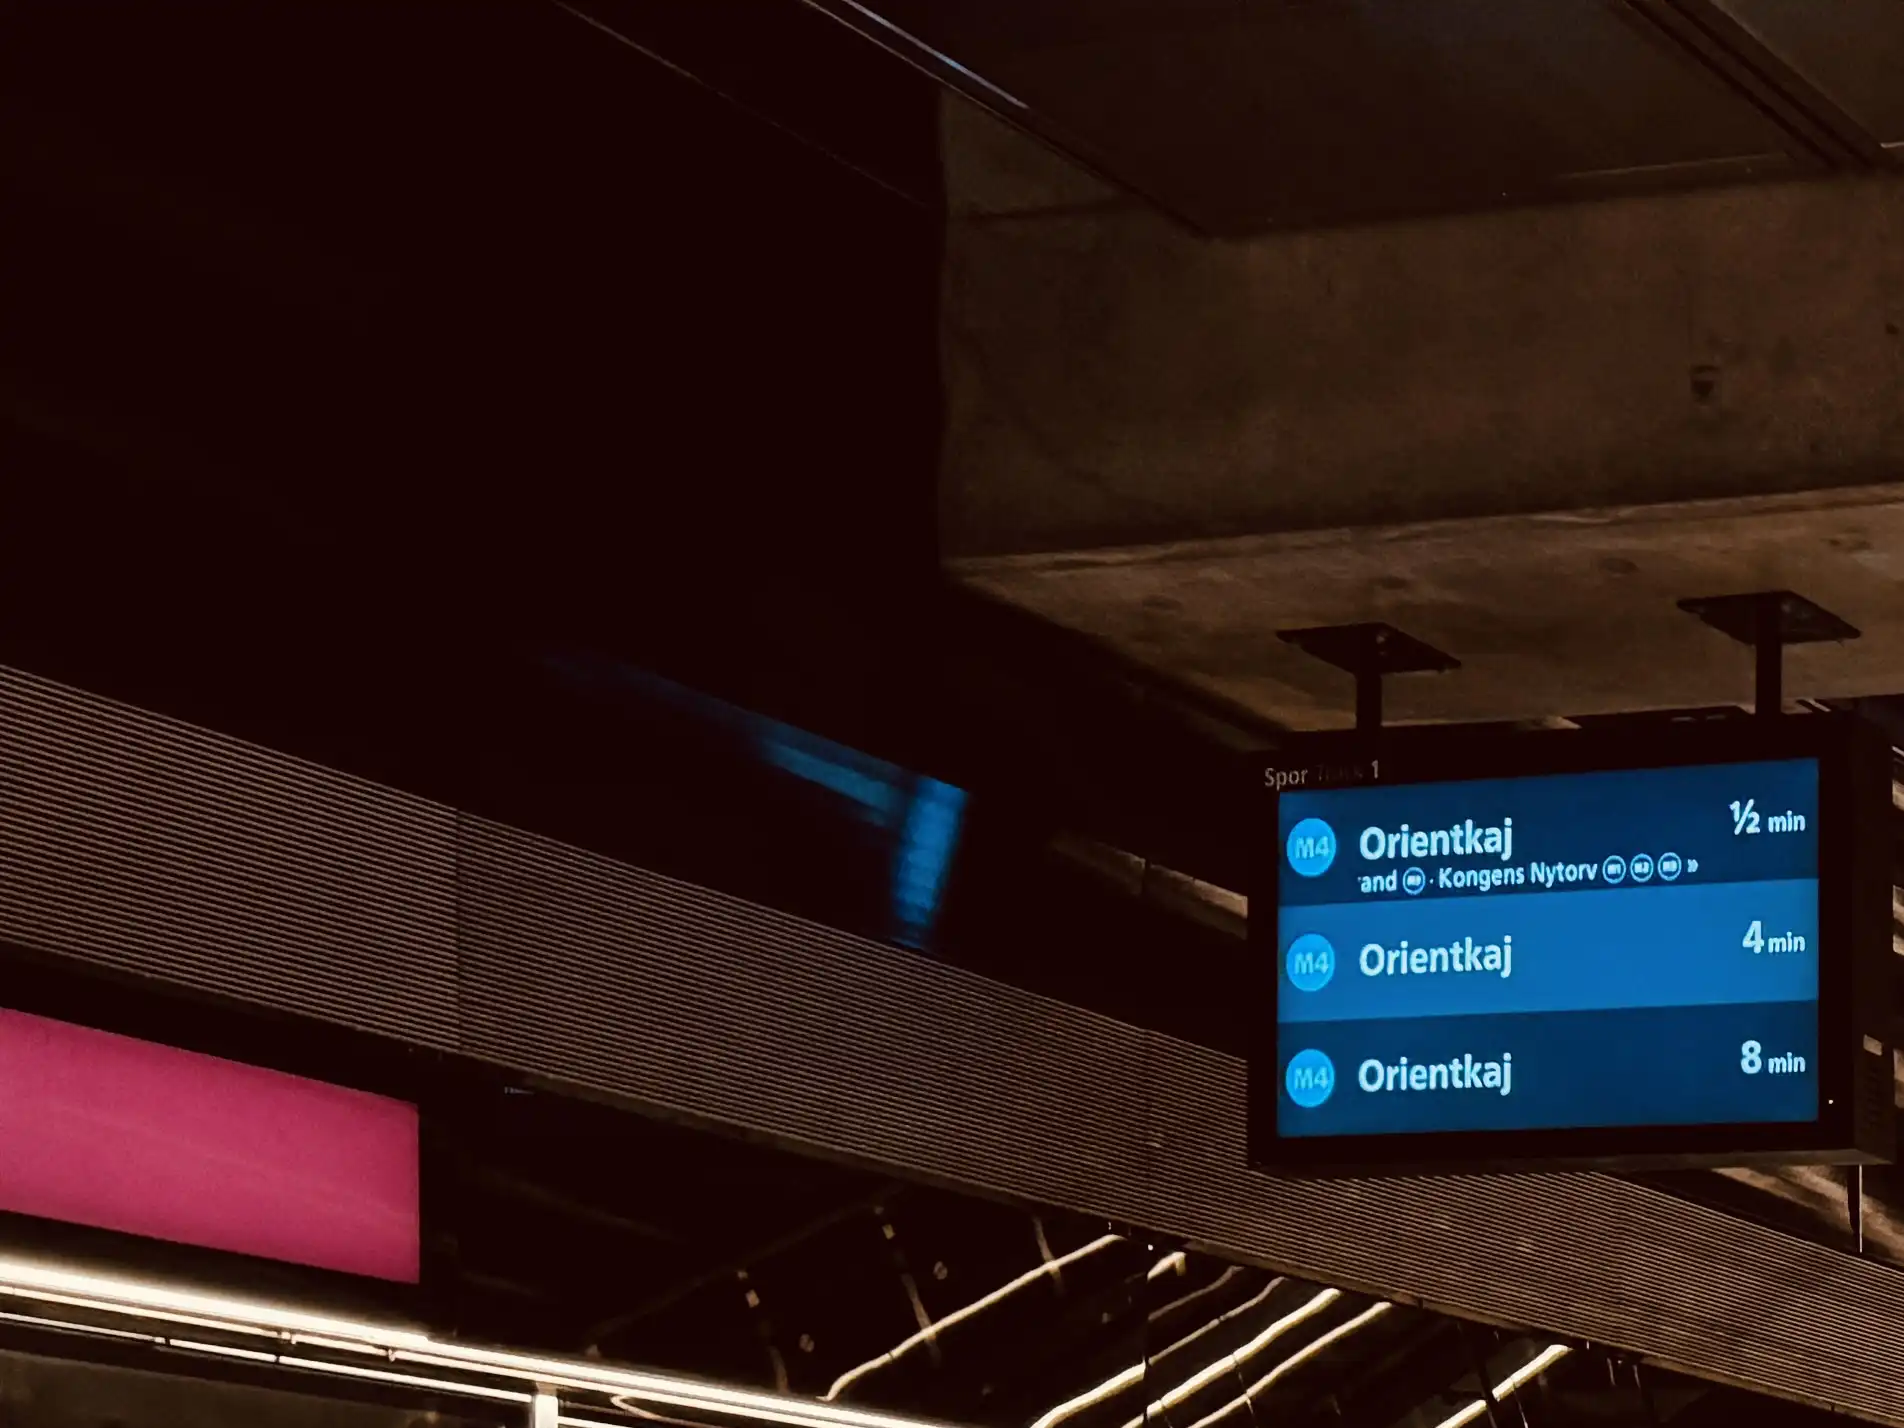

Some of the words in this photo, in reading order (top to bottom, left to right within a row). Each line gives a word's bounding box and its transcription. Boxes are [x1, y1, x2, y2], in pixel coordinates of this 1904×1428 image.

[1264, 768, 1308, 791] Spor
[1371, 758, 1380, 780] 1
[1294, 836, 1331, 860] M4
[1360, 817, 1513, 862] Orientkaj
[1768, 810, 1806, 833] min
[1357, 868, 1397, 893] and
[1438, 860, 1525, 892] Kongens
[1530, 861, 1598, 888] Nytorv
[1293, 951, 1330, 976] M4
[1360, 934, 1512, 979] Orientkaj
[1742, 920, 1765, 954] 4
[1768, 931, 1806, 953] min
[1293, 1066, 1330, 1092] M4
[1358, 1052, 1512, 1096] Orientkaj
[1740, 1040, 1762, 1074] 8
[1768, 1051, 1806, 1073] min
